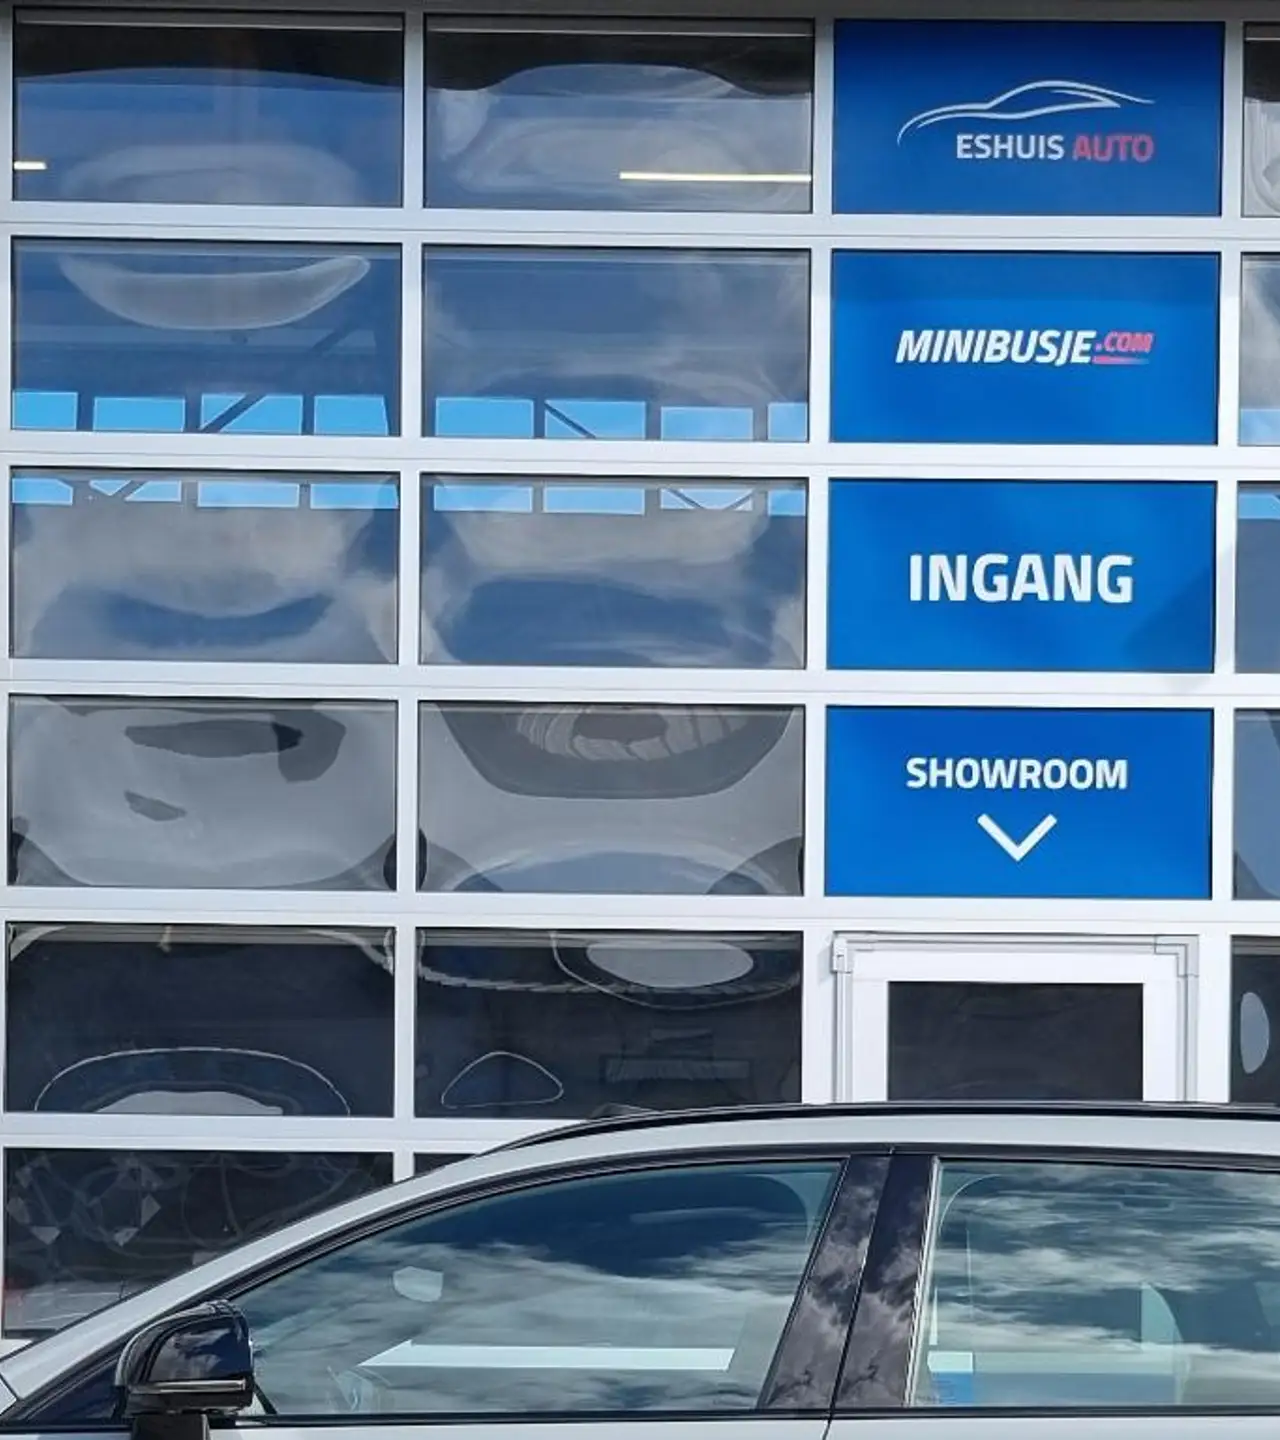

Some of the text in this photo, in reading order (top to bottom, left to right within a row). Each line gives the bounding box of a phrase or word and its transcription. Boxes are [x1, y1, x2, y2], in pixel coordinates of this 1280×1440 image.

[956, 134, 1155, 163] ESHUIS AUTO
[909, 553, 1134, 604] INGANG
[906, 756, 1128, 790] SHOWROOM
